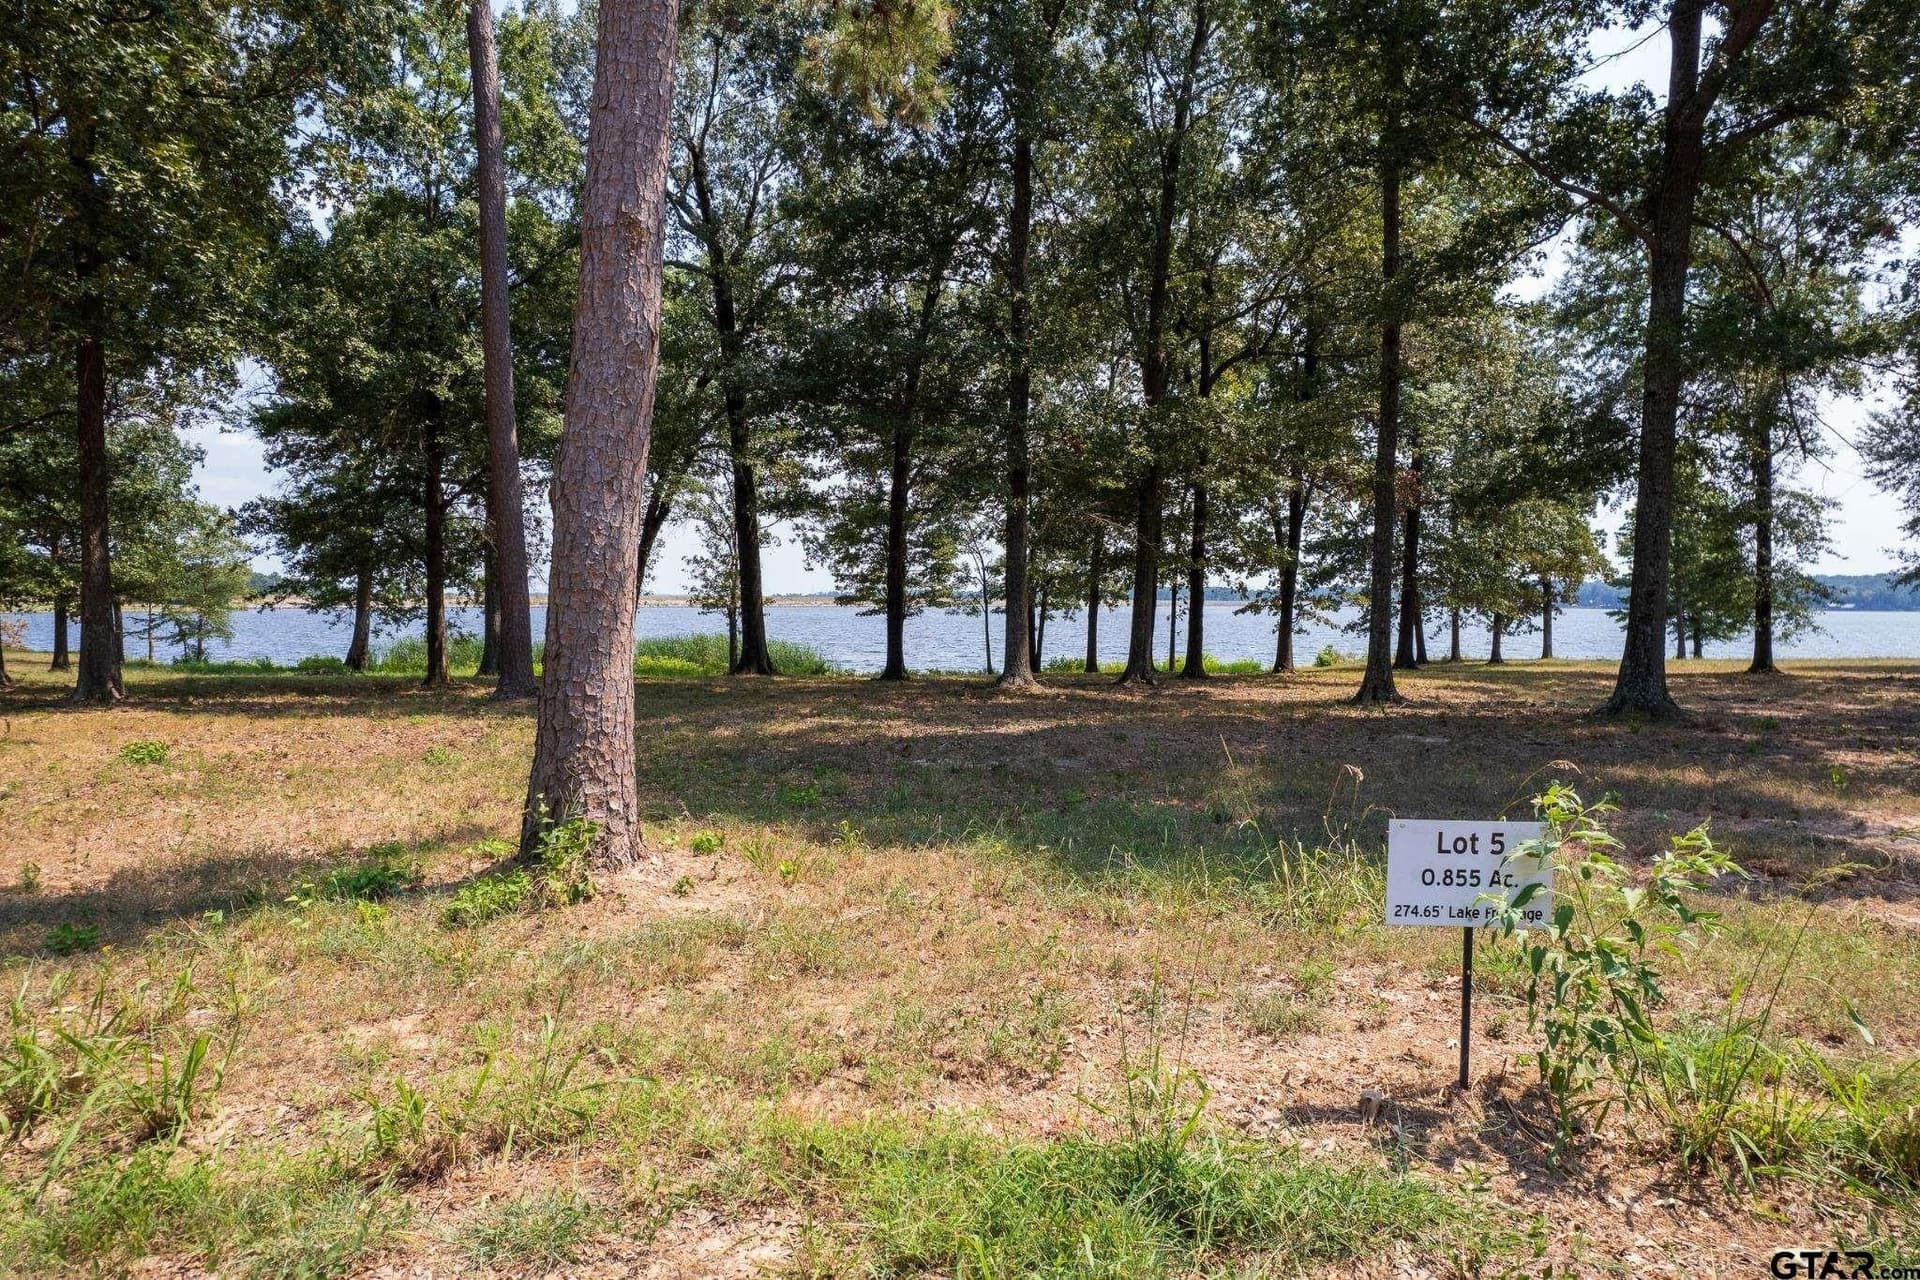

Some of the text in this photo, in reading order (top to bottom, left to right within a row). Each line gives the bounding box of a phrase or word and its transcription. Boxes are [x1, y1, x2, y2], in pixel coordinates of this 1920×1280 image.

[1437, 831, 1505, 855] Lot 5
[1421, 868, 1519, 888] 0.855 Ac.
[1394, 904, 1543, 923] 274.65' Lake Frage
